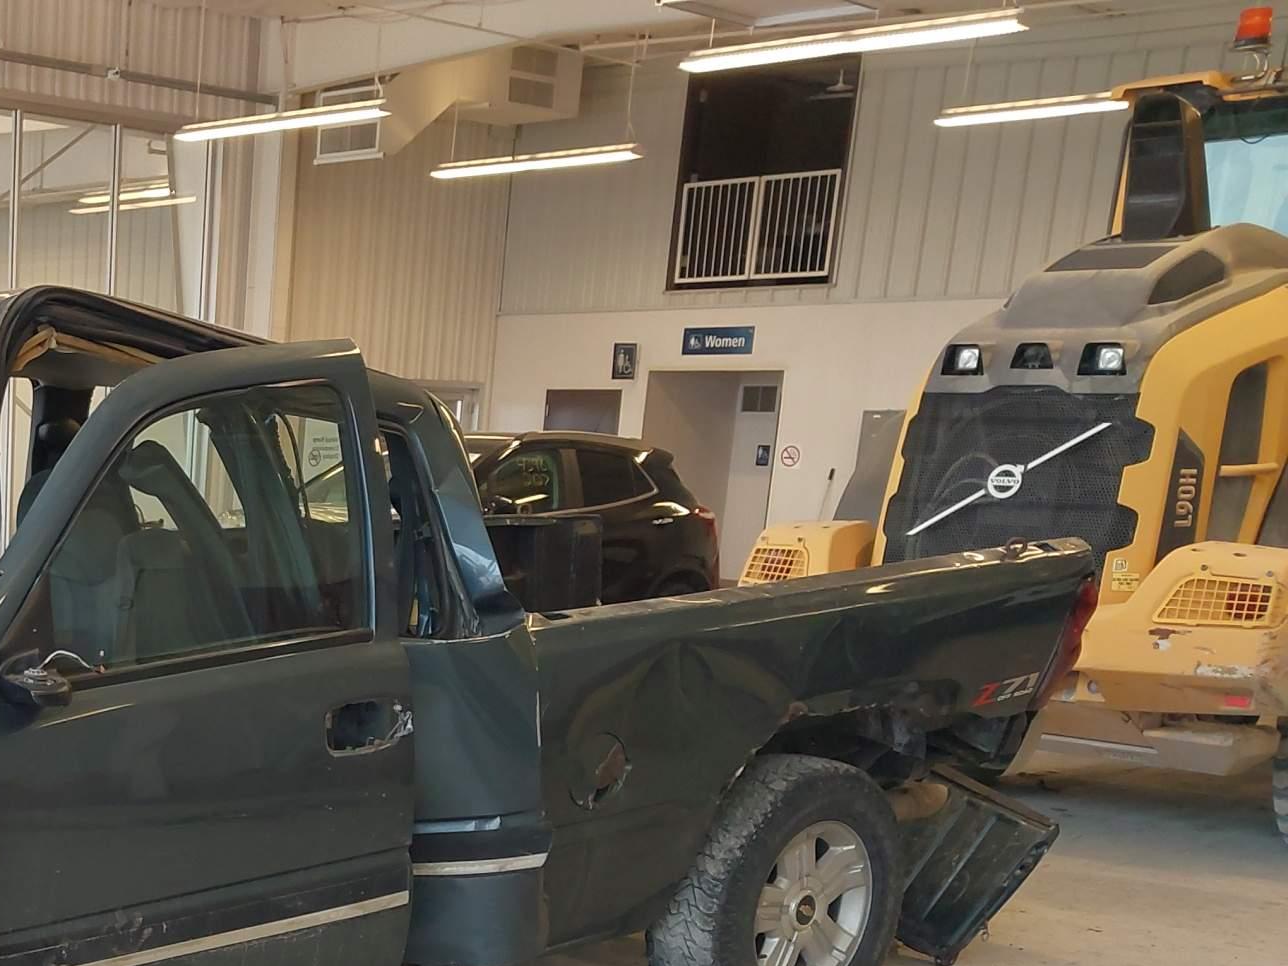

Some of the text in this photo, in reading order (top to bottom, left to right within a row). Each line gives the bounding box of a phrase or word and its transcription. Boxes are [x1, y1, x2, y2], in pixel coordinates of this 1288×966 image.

[705, 335, 745, 348] Women
[1173, 468, 1198, 528] L90H
[970, 671, 1040, 706] Z71
